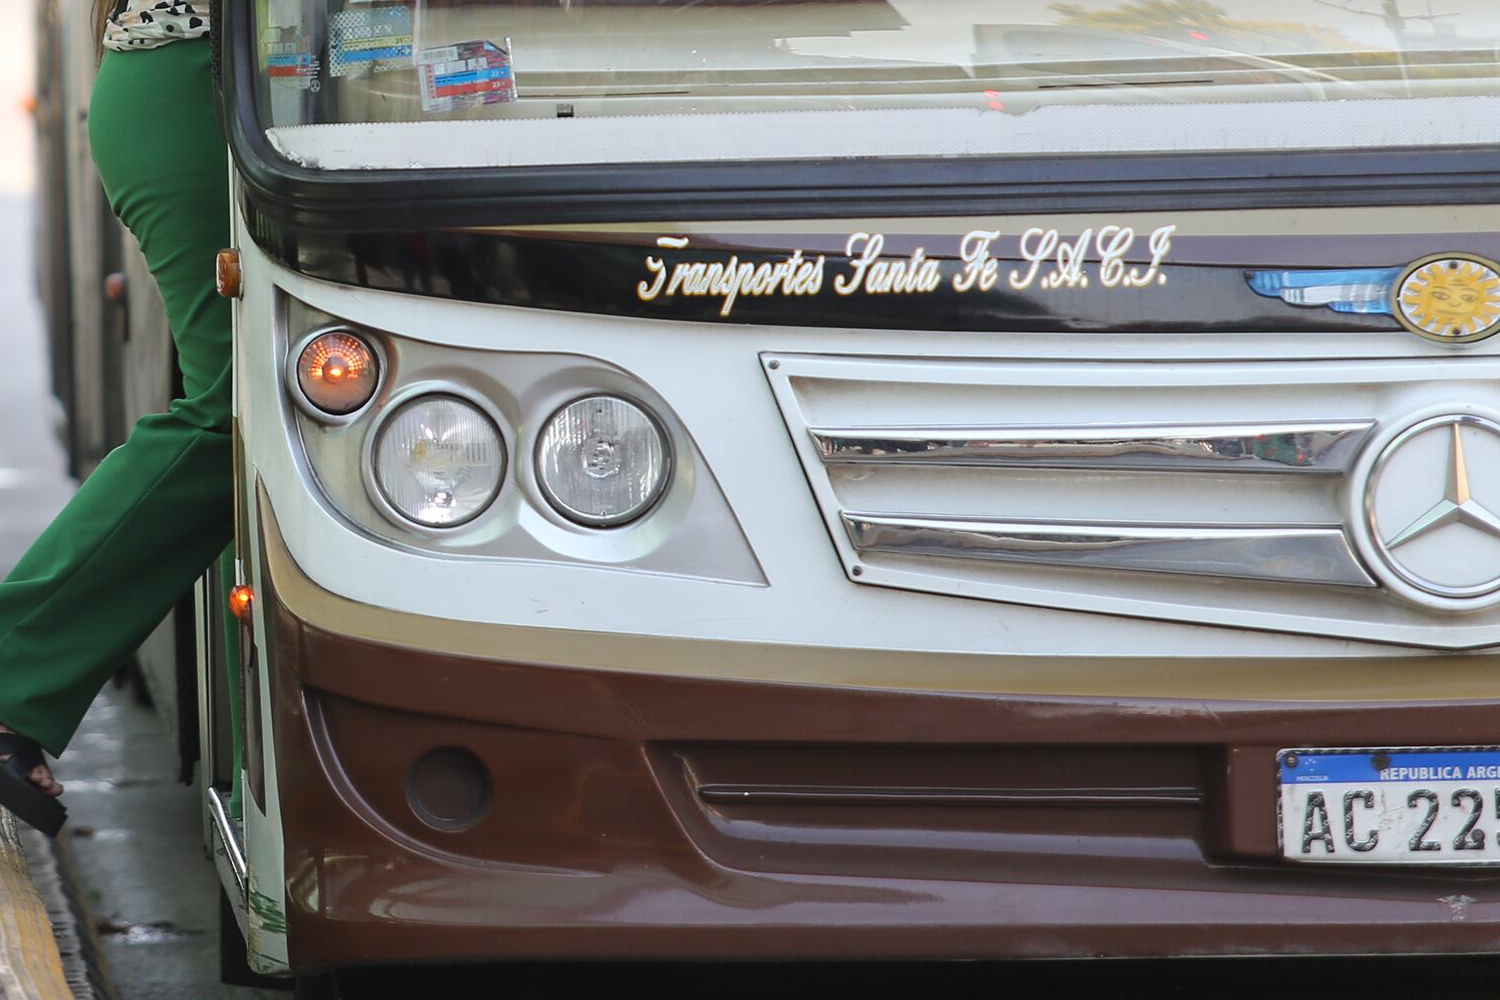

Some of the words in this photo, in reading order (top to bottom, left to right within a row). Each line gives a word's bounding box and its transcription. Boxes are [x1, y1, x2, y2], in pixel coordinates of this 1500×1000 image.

[637, 235, 825, 317] Transportes
[834, 232, 941, 295] Santa
[953, 230, 1000, 293] Fe
[1380, 766, 1462, 781] REPUBLICA
[1302, 790, 1379, 853] AC
[1407, 788, 1500, 851] 22
